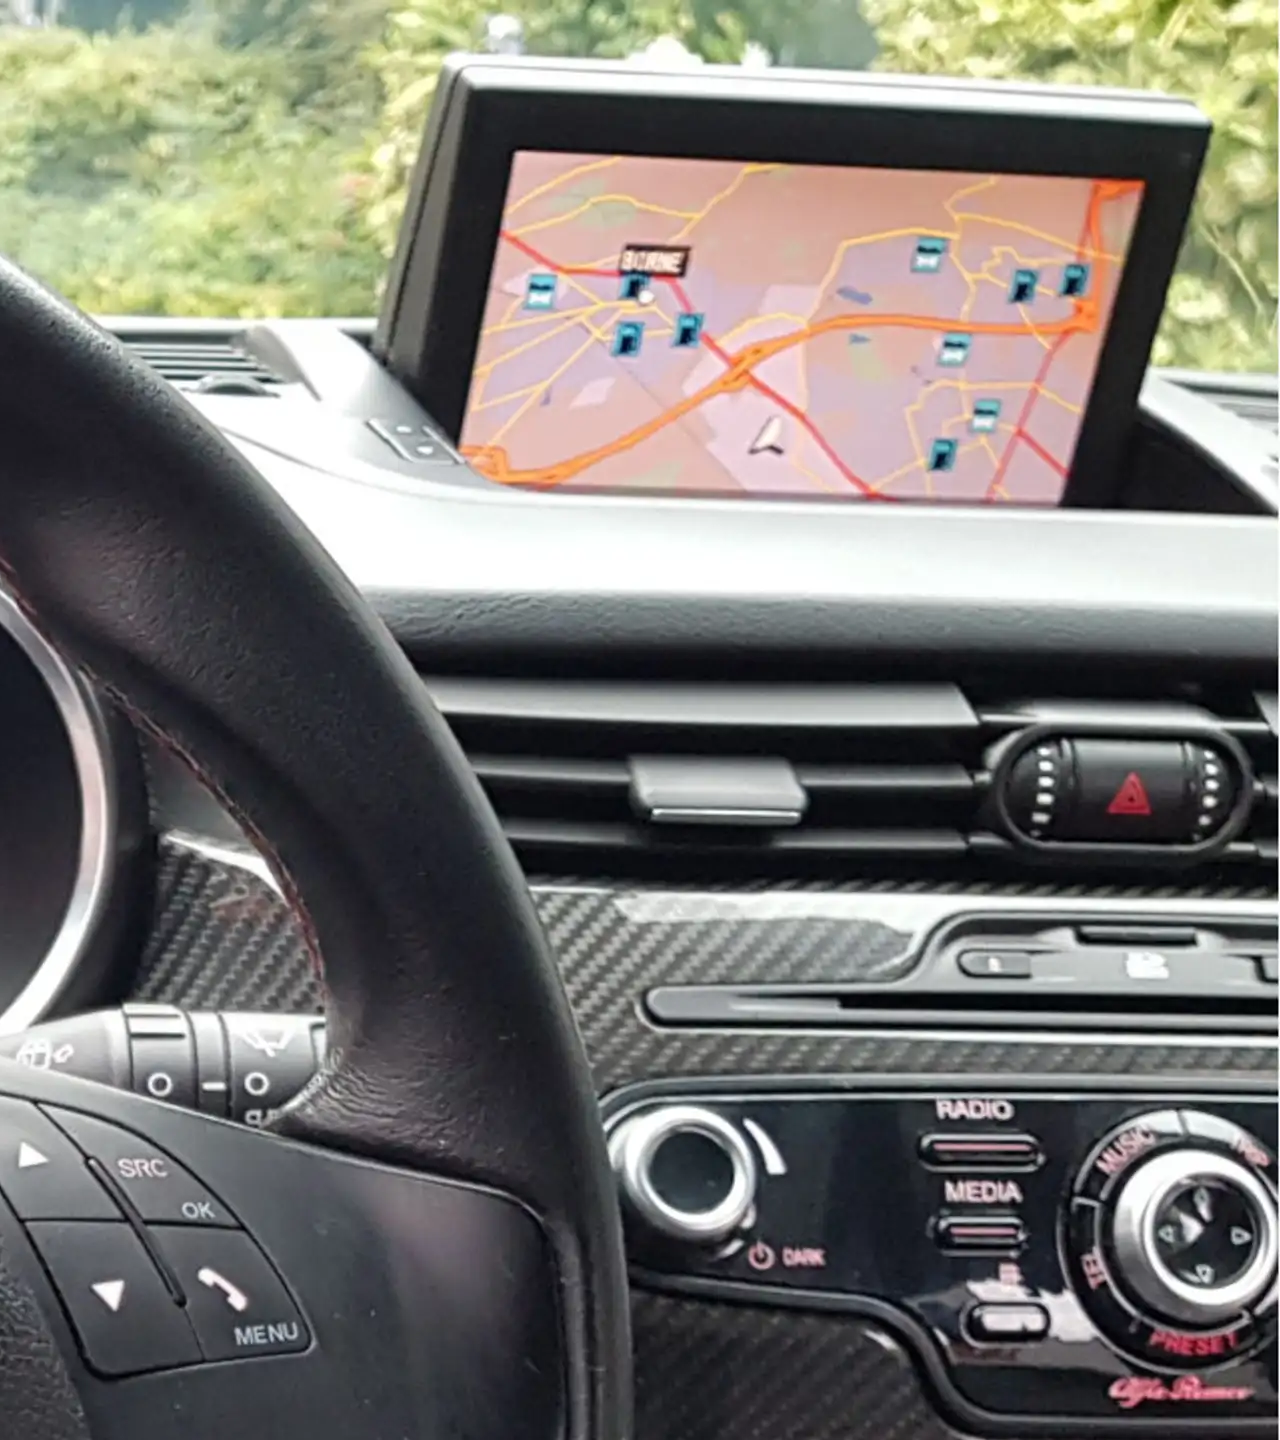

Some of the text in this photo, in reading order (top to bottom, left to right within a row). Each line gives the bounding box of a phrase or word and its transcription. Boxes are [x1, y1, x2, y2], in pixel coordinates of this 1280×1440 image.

[935, 1098, 1016, 1121] RADIO
[1095, 1124, 1157, 1175] MUSIC
[117, 1157, 169, 1180] SRC
[944, 1179, 1024, 1204] MEDIA
[181, 1202, 216, 1220] OK
[782, 1246, 827, 1268] DARK
[234, 1321, 299, 1346] MENU
[1148, 1328, 1239, 1356] PRESET
